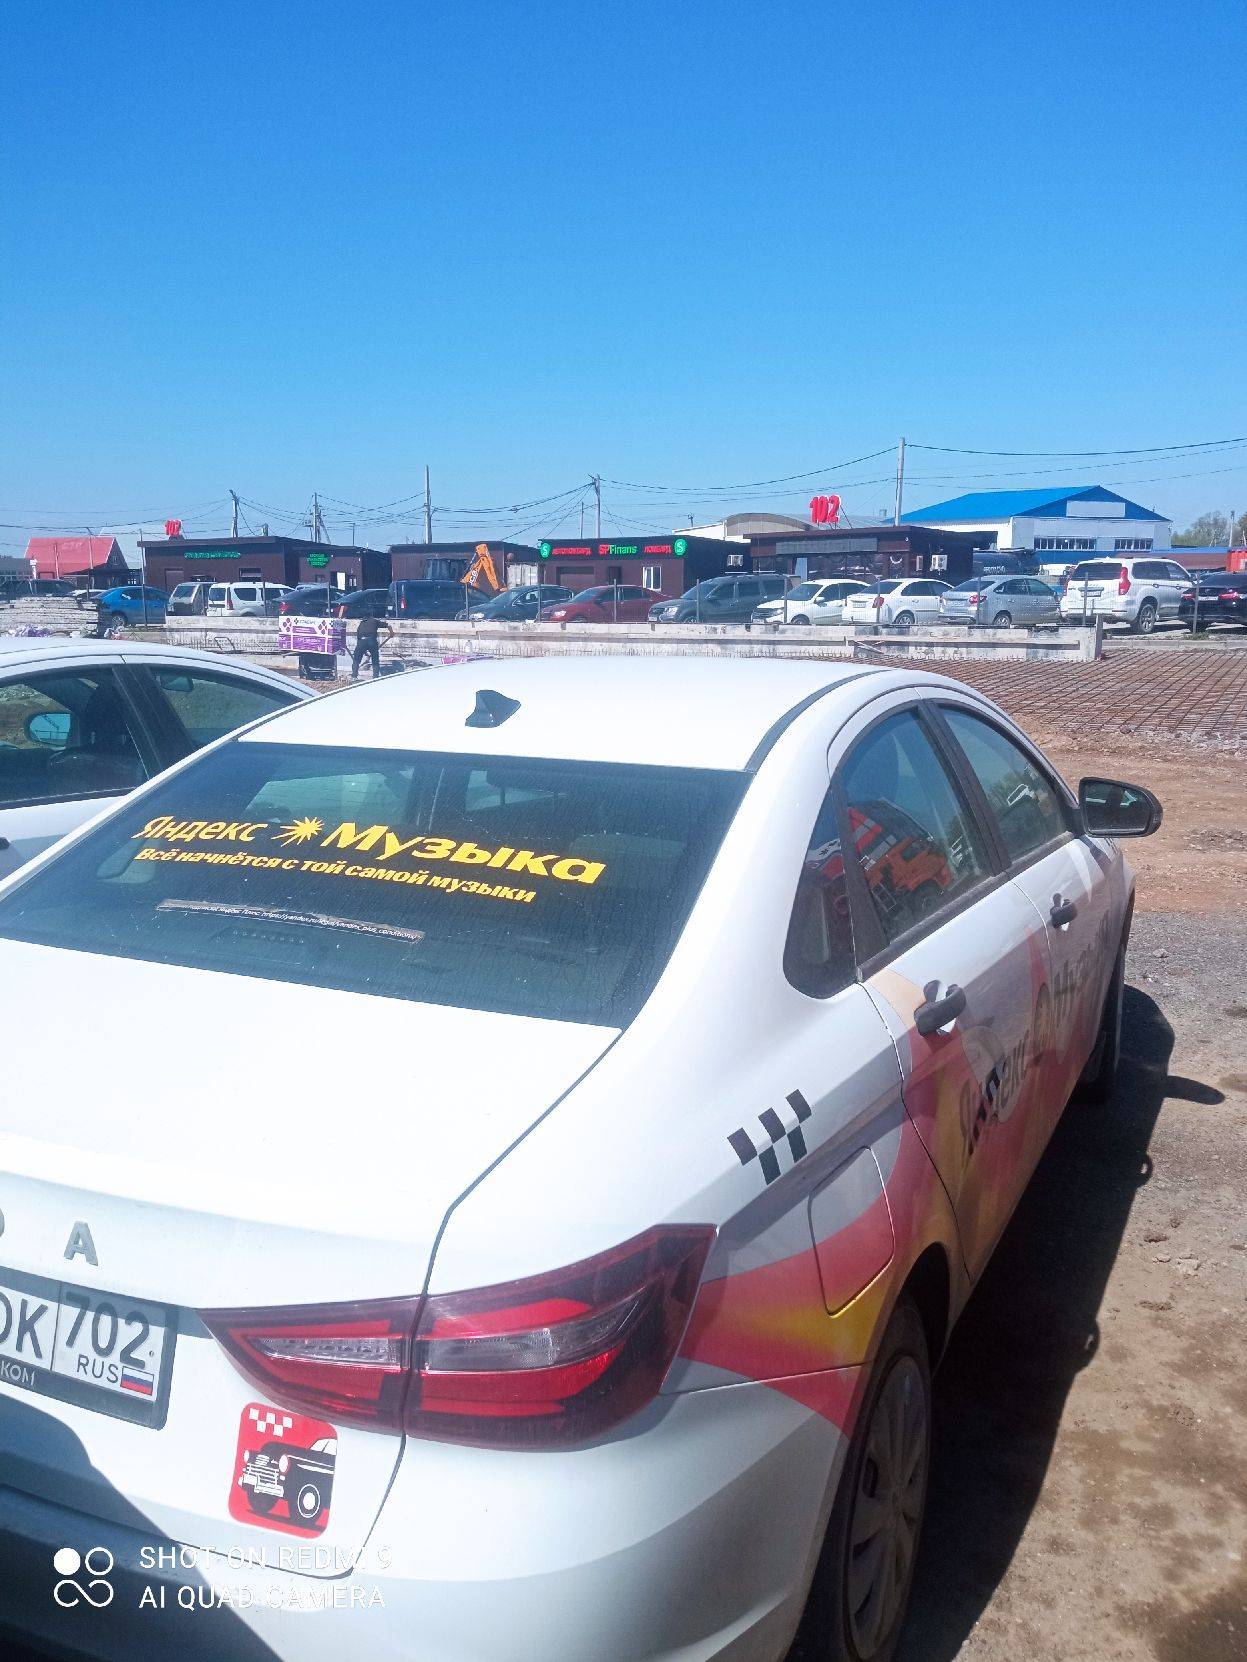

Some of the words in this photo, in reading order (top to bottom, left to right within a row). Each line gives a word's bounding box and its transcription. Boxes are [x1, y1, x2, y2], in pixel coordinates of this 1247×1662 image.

[810, 494, 842, 524] 102
[131, 815, 268, 842] Яндекс
[320, 822, 606, 884] Музыка
[134, 848, 180, 861] Всё
[175, 849, 283, 869] начнётся
[281, 859, 299, 870] с
[300, 860, 348, 875] той
[344, 865, 433, 886] самой
[429, 876, 537, 903] музыки
[65, 1291, 150, 1370] 702
[77, 1354, 119, 1384] RUS
